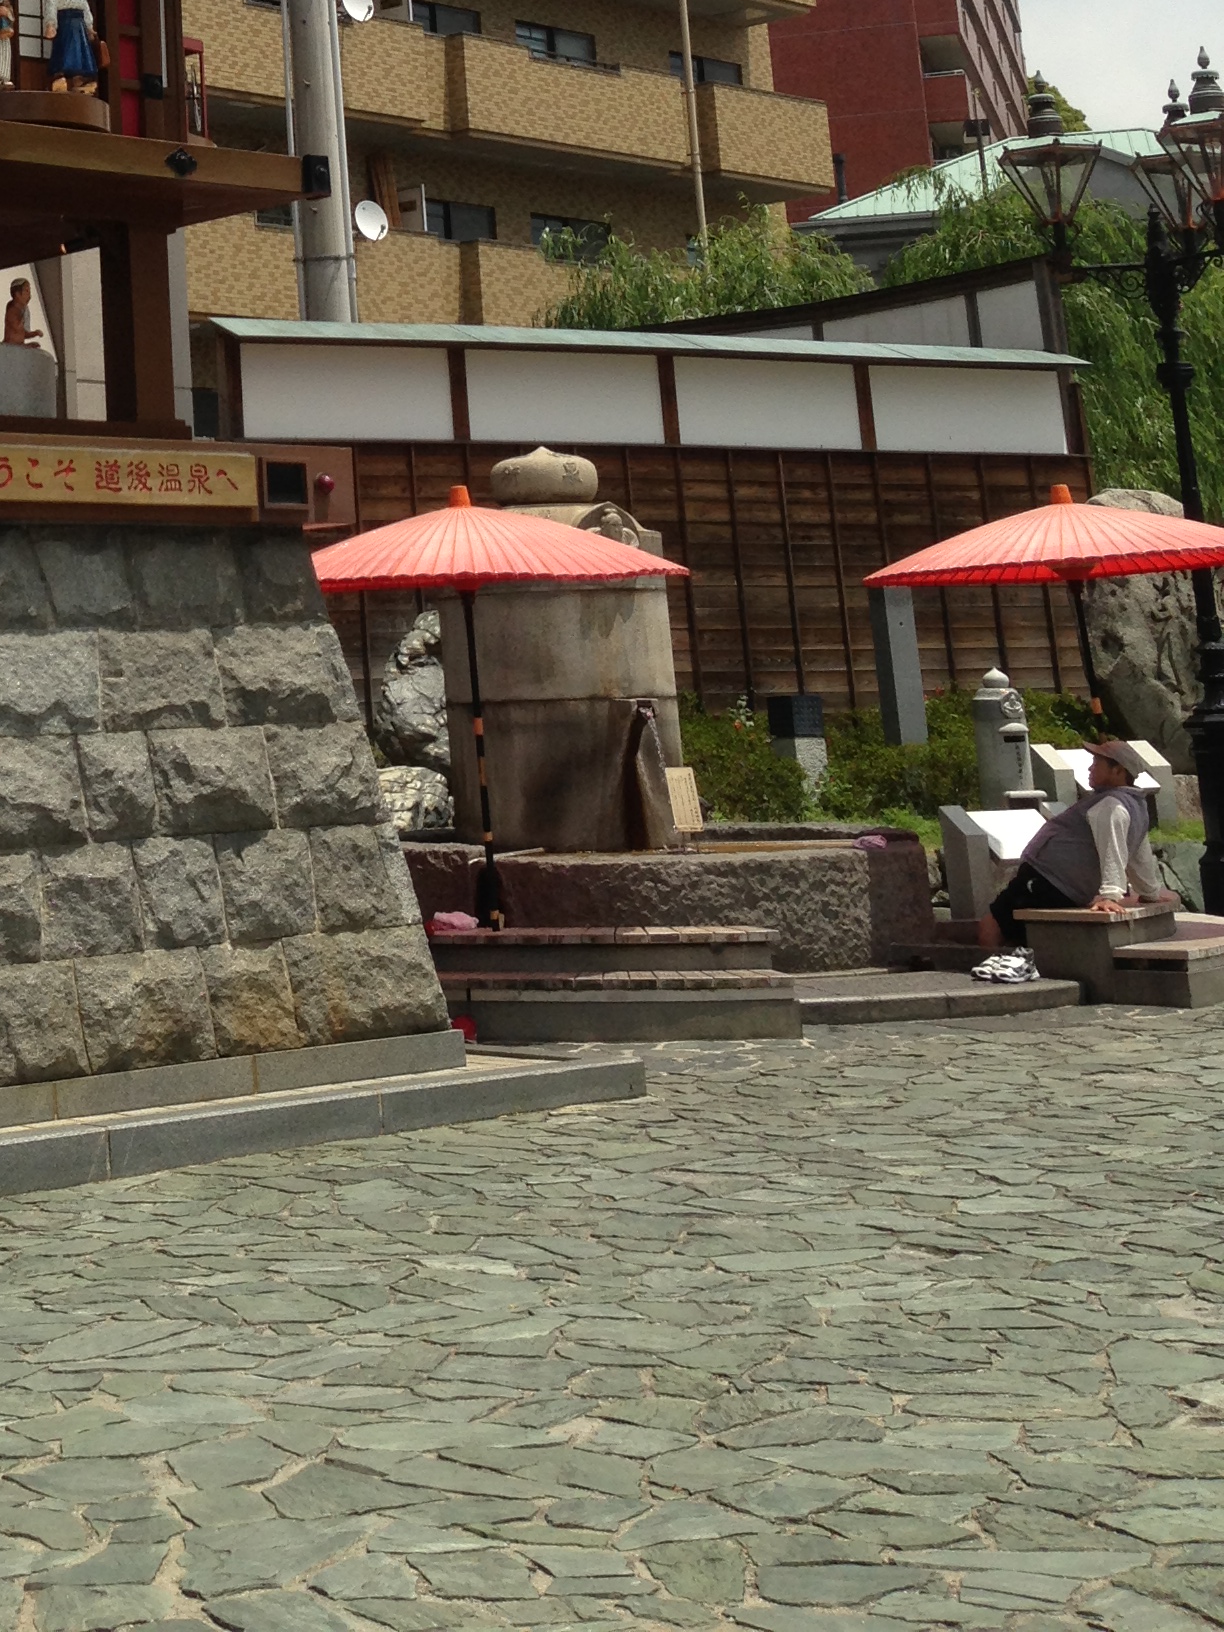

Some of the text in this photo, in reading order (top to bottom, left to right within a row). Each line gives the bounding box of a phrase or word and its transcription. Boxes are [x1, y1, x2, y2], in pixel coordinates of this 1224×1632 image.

[94, 459, 239, 495] 道後温泉へ
